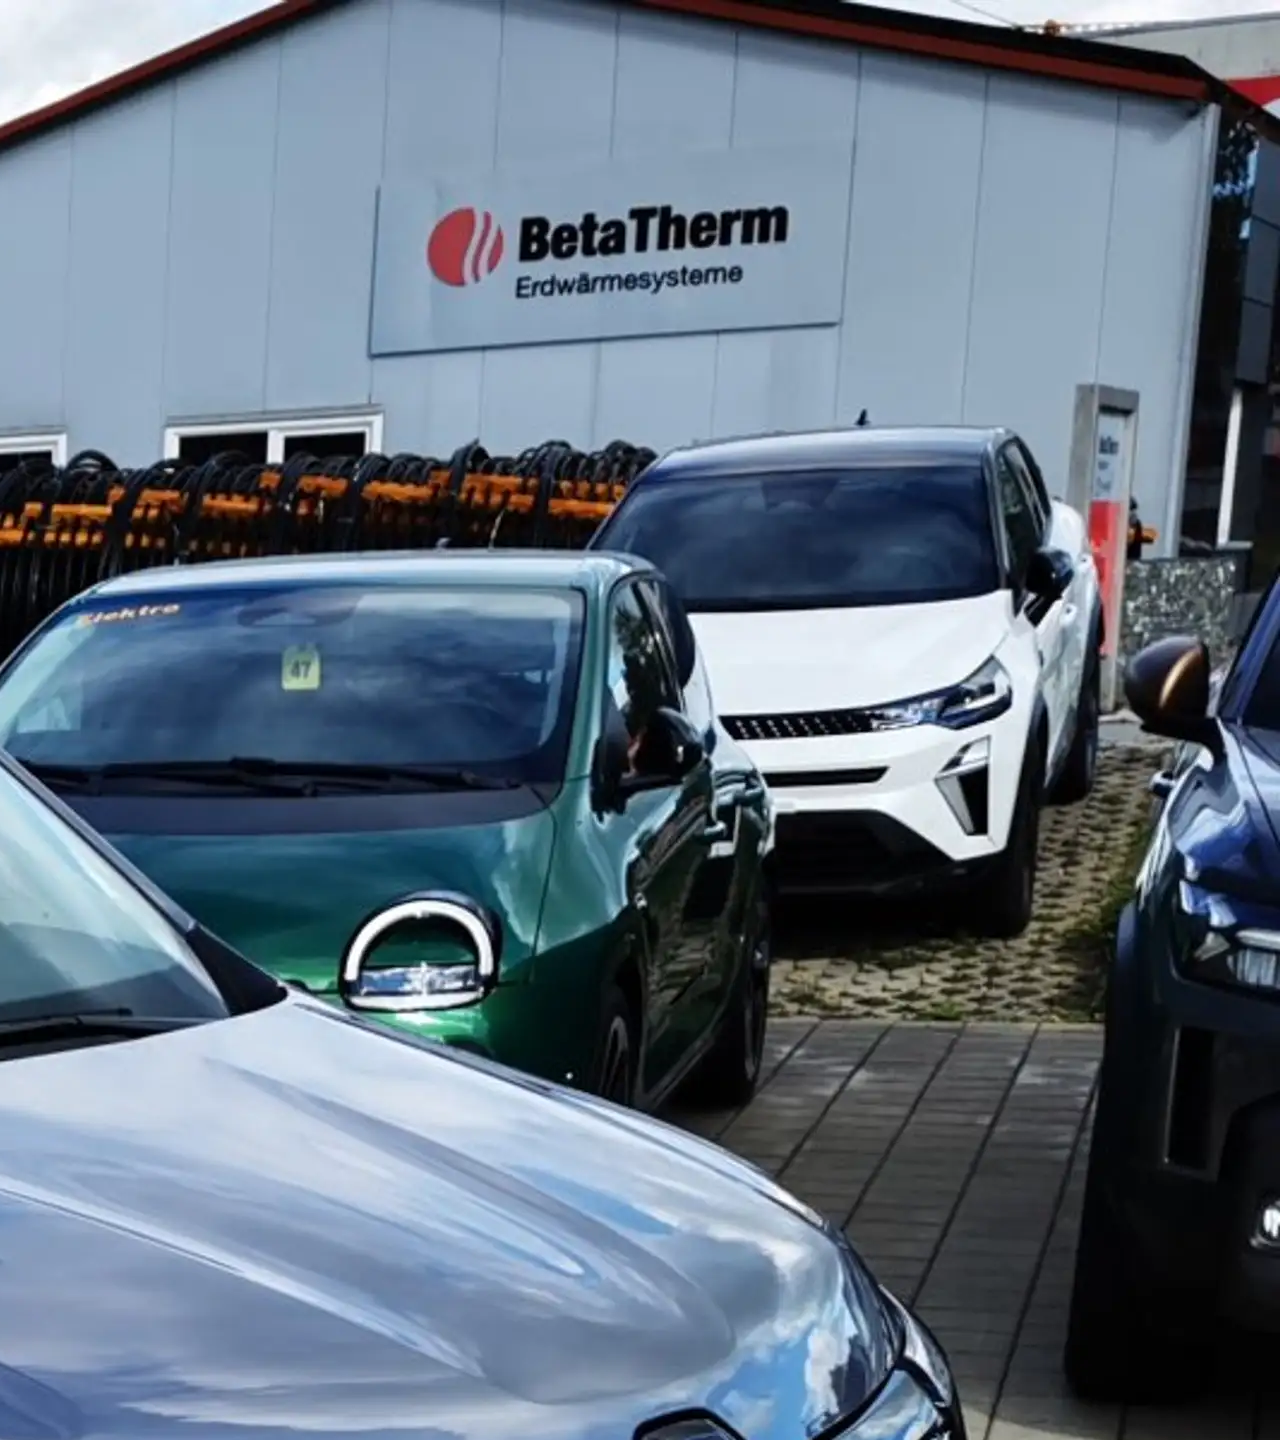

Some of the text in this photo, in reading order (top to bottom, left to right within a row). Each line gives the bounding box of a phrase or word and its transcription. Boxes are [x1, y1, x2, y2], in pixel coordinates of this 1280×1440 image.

[518, 204, 789, 263] BetaTherm
[515, 264, 744, 300] Erdwärmesysteme
[290, 660, 312, 680] 47
